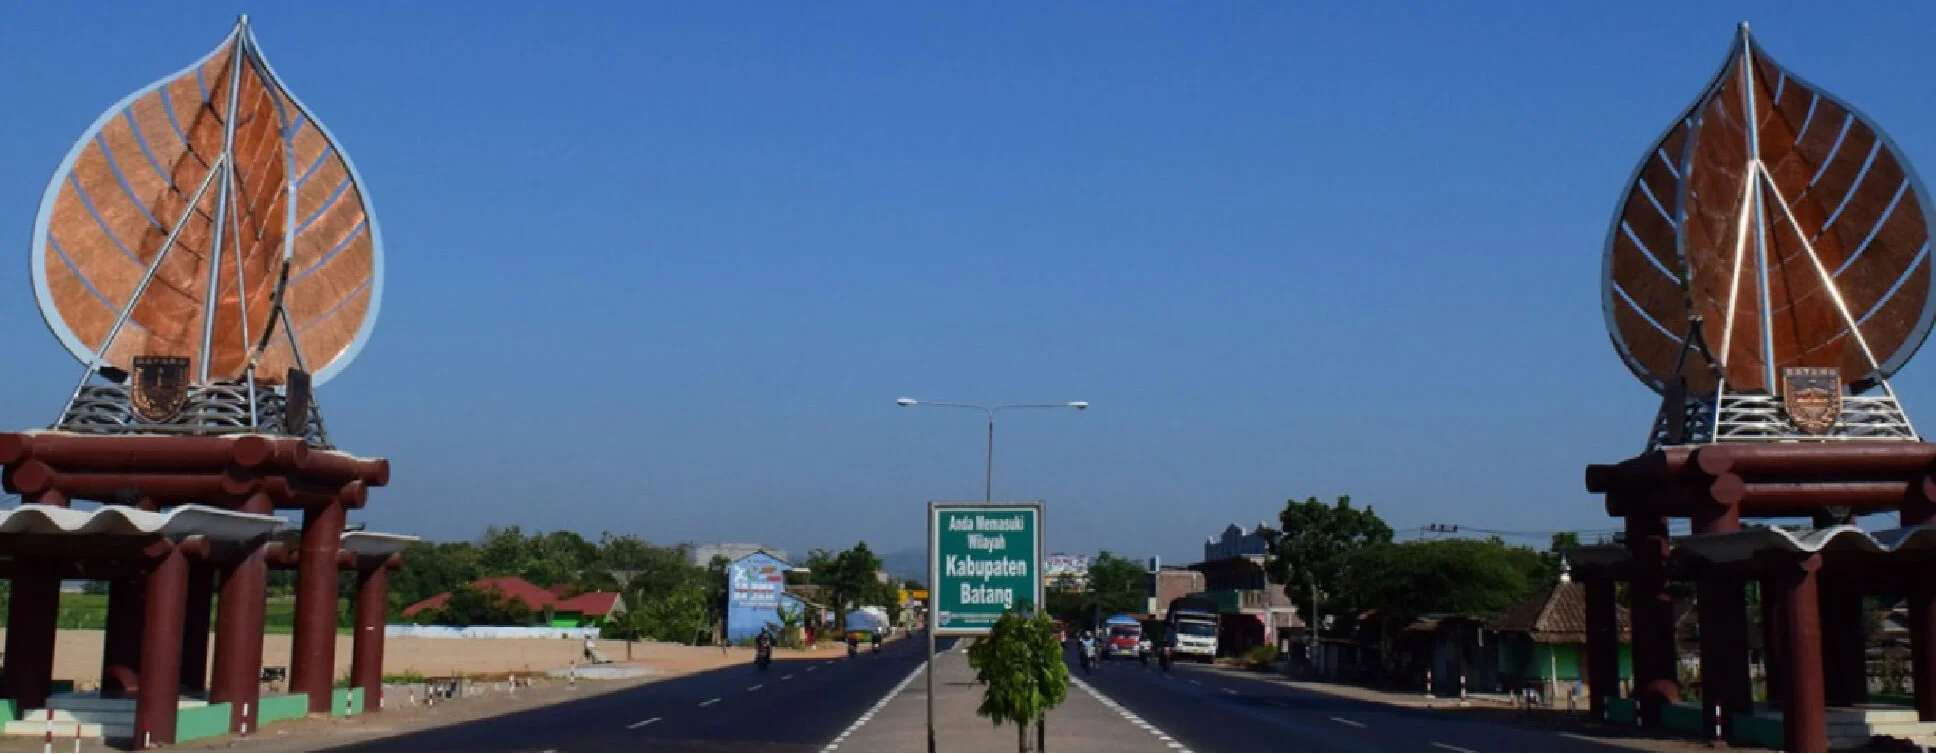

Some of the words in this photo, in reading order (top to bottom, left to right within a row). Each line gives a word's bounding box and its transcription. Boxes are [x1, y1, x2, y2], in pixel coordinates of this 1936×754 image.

[949, 515, 974, 531] Anda
[976, 515, 1024, 531] Memasuki
[968, 534, 1006, 553] Wilayah
[946, 554, 1027, 582] Kabupaten
[960, 583, 1013, 609] Batang
